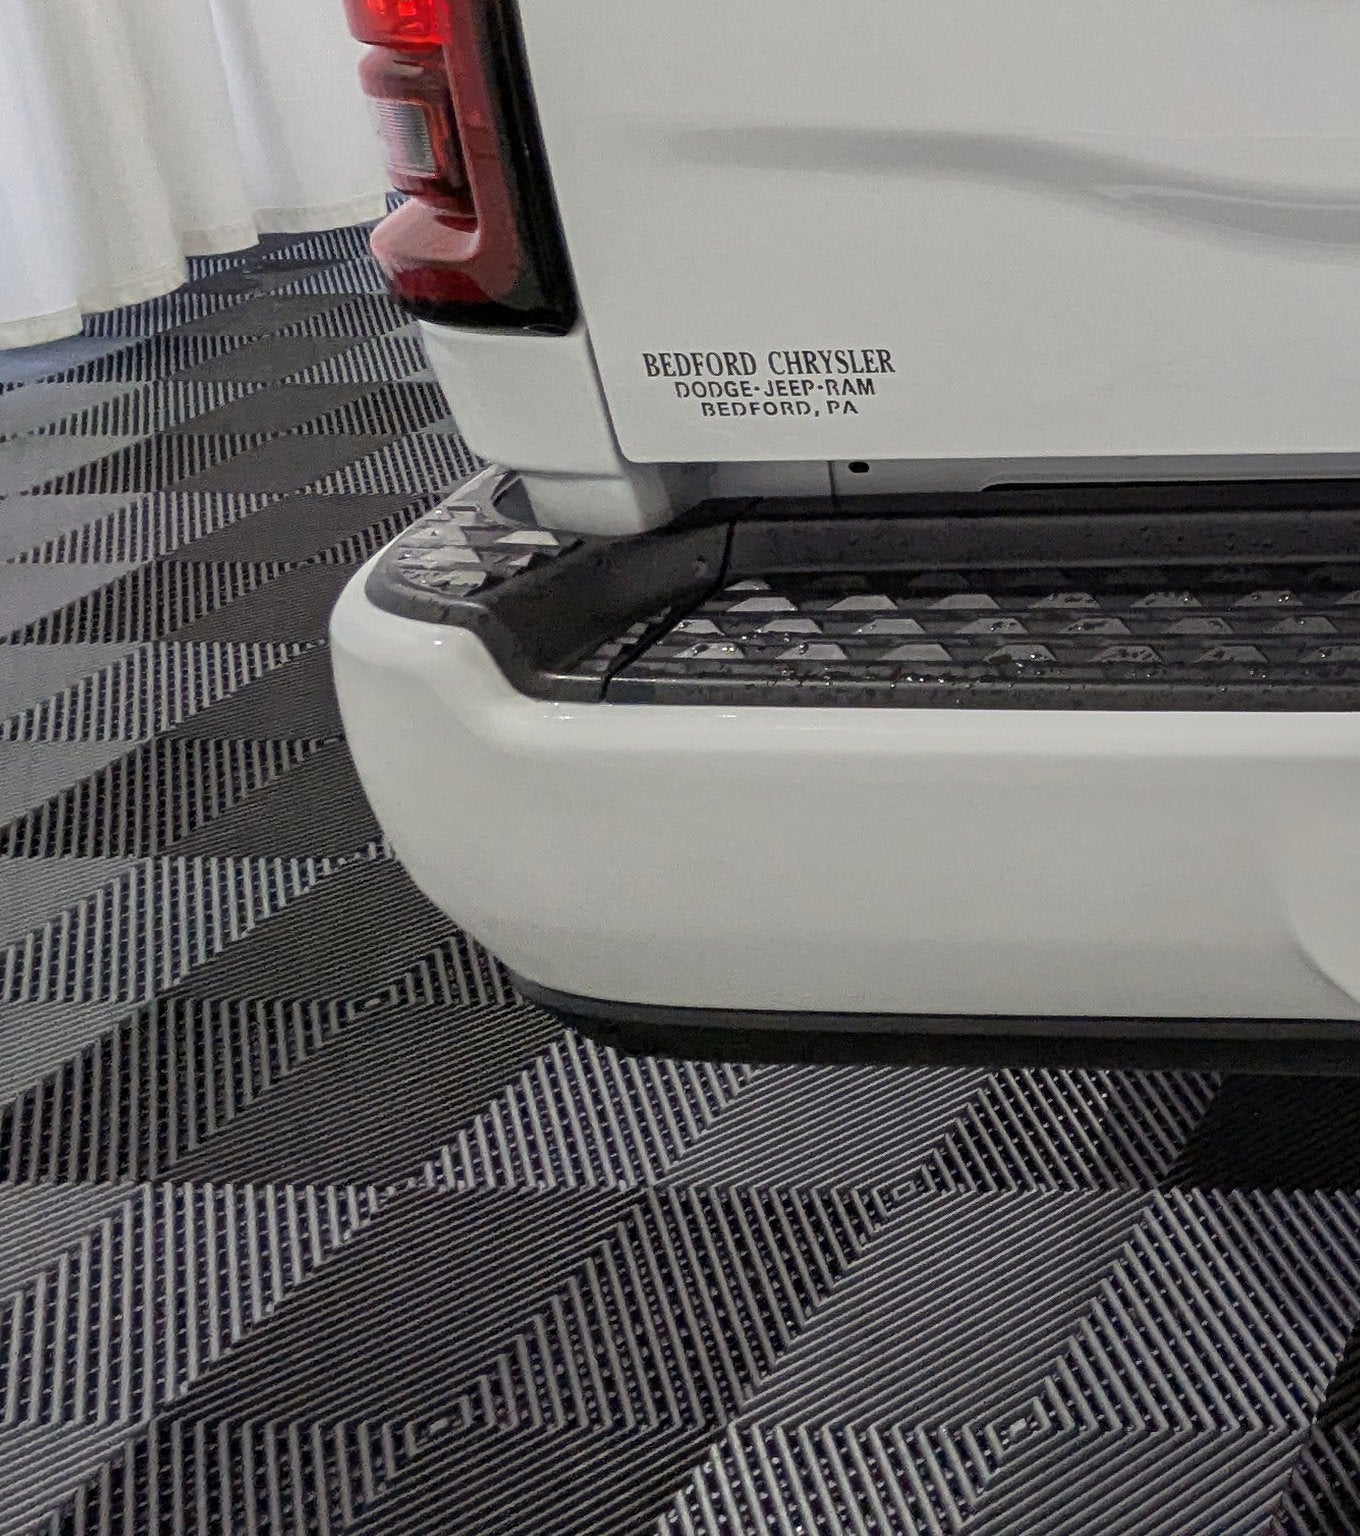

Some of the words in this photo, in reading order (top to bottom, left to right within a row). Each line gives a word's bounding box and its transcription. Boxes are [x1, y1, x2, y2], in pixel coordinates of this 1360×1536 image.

[642, 351, 758, 377] BEDFORD
[767, 349, 896, 375] CHRYSLER
[701, 401, 820, 417] BEDFORD,
[827, 400, 859, 415] PA
